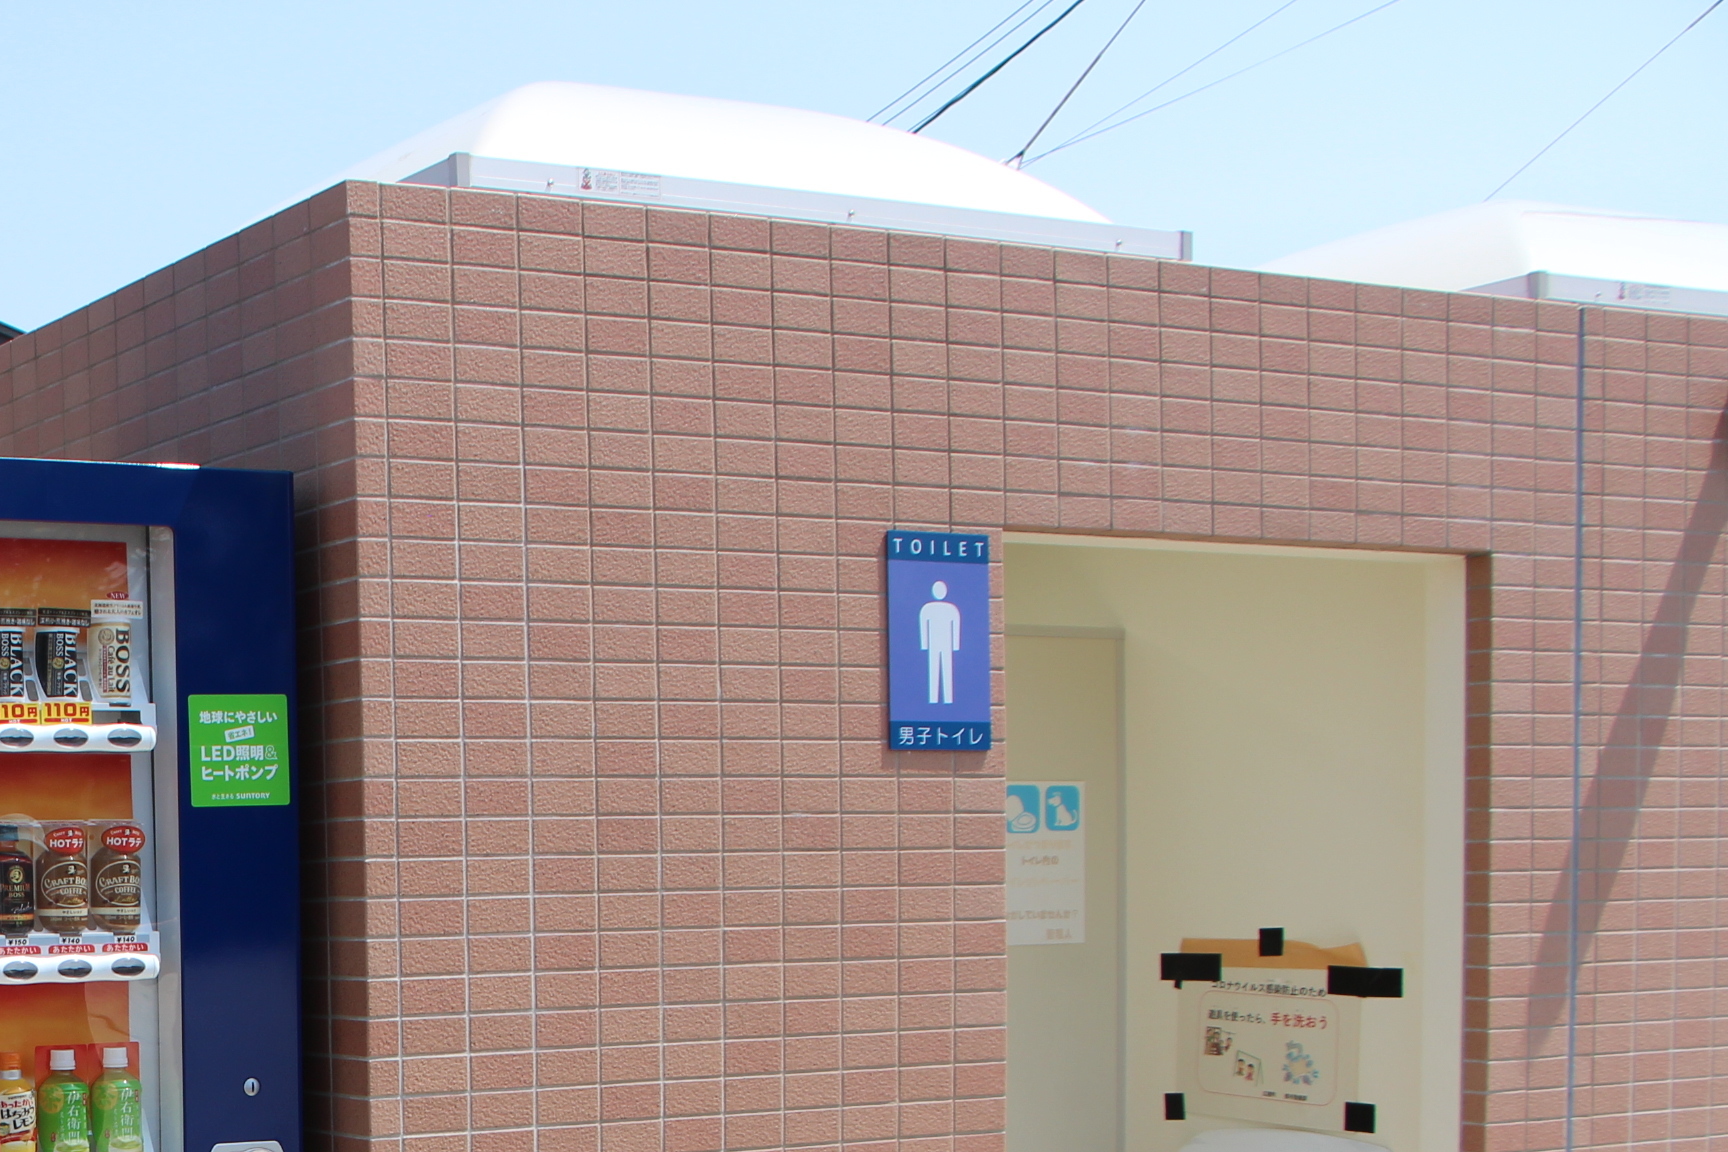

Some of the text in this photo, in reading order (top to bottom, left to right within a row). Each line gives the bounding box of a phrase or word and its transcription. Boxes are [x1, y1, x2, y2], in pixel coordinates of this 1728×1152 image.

[892, 538, 984, 558] TOILET
[1, 633, 9, 656] BOSS
[55, 633, 64, 657] BOSS
[10, 633, 23, 697] BLACK
[64, 633, 77, 697] BLACK
[116, 628, 130, 694] BOSS
[45, 703, 89, 718] 110円
[199, 711, 278, 724] 地球にやさしい
[227, 727, 253, 741] 省エネ!
[898, 726, 984, 746] 男子トイレ
[201, 745, 278, 762] LED照明&
[201, 764, 279, 782] ヒートポンプ
[236, 792, 270, 800] SUNTORY
[50, 838, 84, 848] HOTラテ
[106, 837, 142, 847] HOTラテ
[0, 883, 30, 892] PREMIUM
[45, 877, 74, 888] CRAFT
[99, 877, 129, 887] CRAFT
[59, 888, 83, 896] COFFEE
[0, 947, 37, 955] あたたかい
[52, 945, 91, 953] あたたかい
[106, 943, 144, 951] あたたかい
[1211, 980, 1327, 998] コロナウイルス感染防止のため
[1208, 1009, 1328, 1030] 遊具を使ったら、 手を洗おう
[0, 1098, 33, 1108] あったかい
[0, 1107, 34, 1119] はちみつ
[67, 1091, 80, 1141] 伊右衛門
[121, 1088, 133, 1139] 伊右衛門
[13, 1117, 34, 1129] レモン
